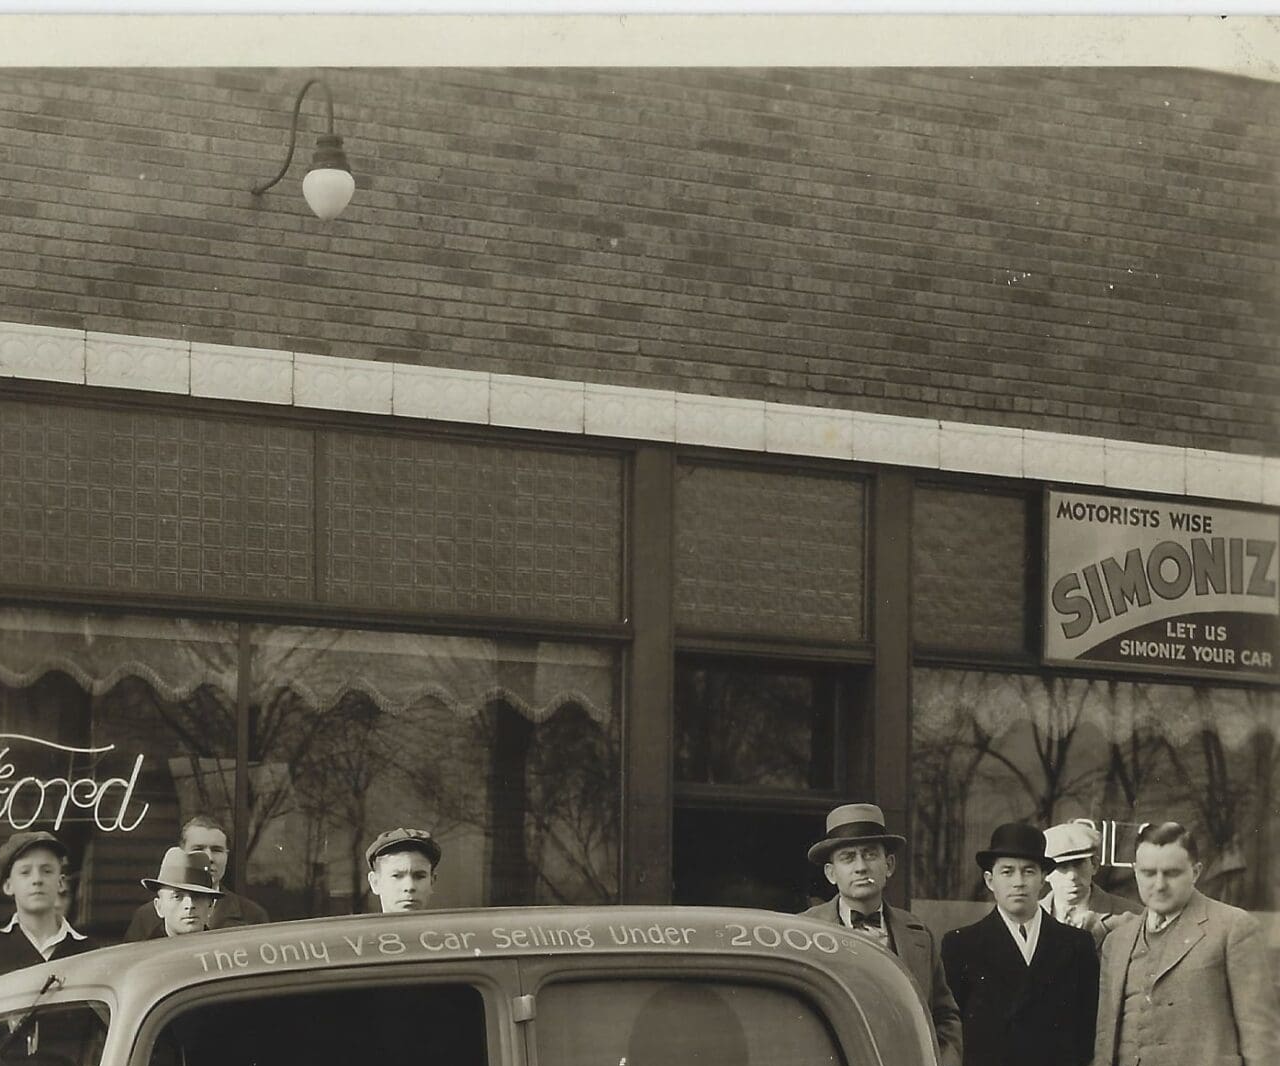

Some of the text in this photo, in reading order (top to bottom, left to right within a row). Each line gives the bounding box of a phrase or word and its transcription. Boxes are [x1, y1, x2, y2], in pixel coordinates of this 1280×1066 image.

[1056, 501, 1213, 534] MOTORISTS WISE
[1051, 537, 1277, 640] SIMONIZ
[1166, 622, 1227, 641] LET US
[1120, 640, 1273, 668] SIMONIZ YOUR CAR
[195, 949, 249, 973] The
[260, 940, 331, 964] Only
[491, 926, 595, 949] Selling
[608, 924, 697, 945] Under
